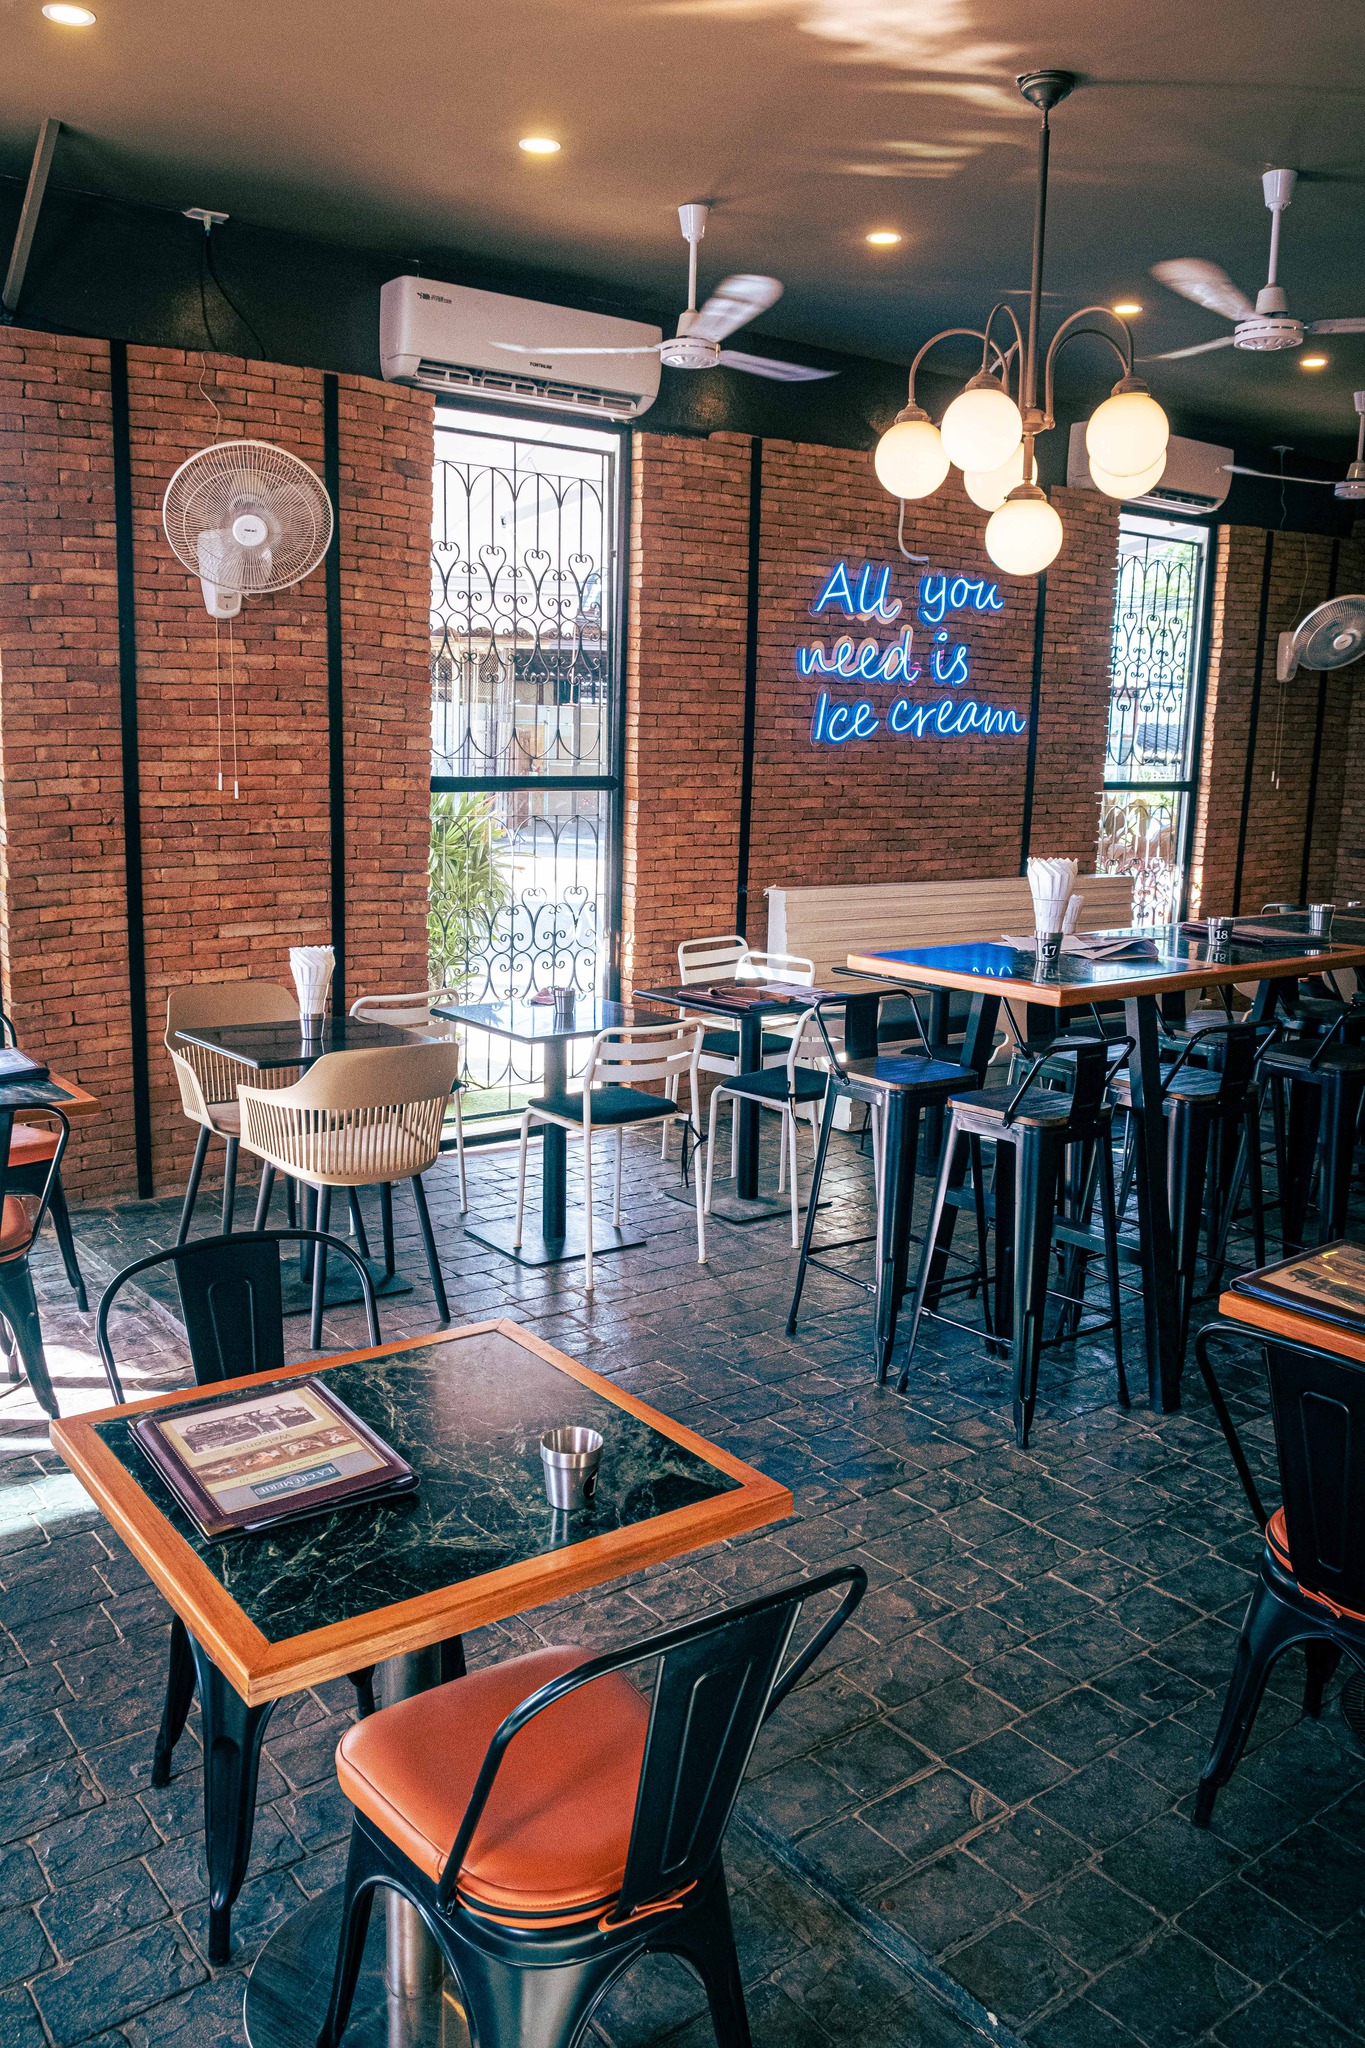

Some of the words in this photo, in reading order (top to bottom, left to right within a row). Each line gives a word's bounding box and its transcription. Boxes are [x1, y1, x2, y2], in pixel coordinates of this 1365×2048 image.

[813, 561, 900, 619] All
[921, 574, 1004, 623] you
[799, 629, 921, 682] need
[933, 631, 969, 686] is
[812, 692, 880, 742] Ice
[891, 699, 1027, 738] cream
[1215, 929, 1228, 940] 18
[1043, 945, 1057, 956] 17
[235, 1434, 292, 1451] Welcome
[316, 1467, 334, 1478] LA
